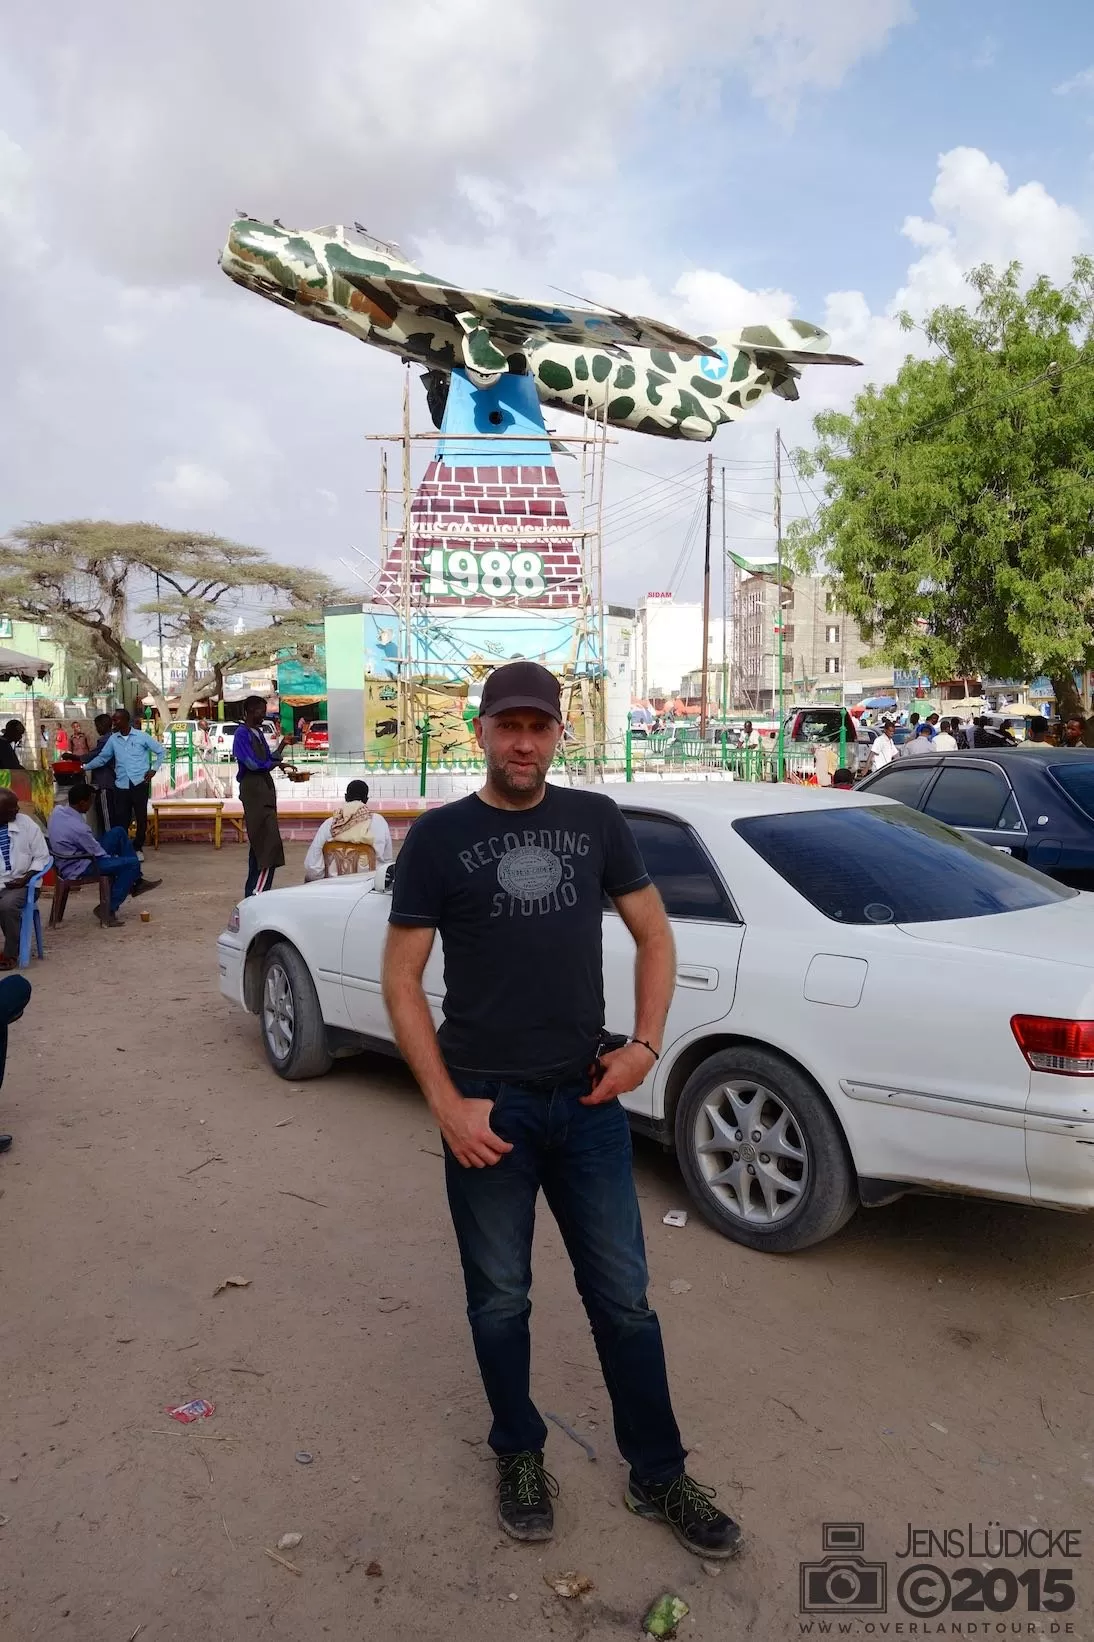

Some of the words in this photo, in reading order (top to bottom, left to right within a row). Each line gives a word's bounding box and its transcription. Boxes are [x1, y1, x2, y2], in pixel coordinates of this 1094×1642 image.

[423, 549, 546, 598] 1988
[457, 829, 590, 874] RECORDING
[561, 854, 575, 880] 5
[489, 881, 578, 918] STUDIO
